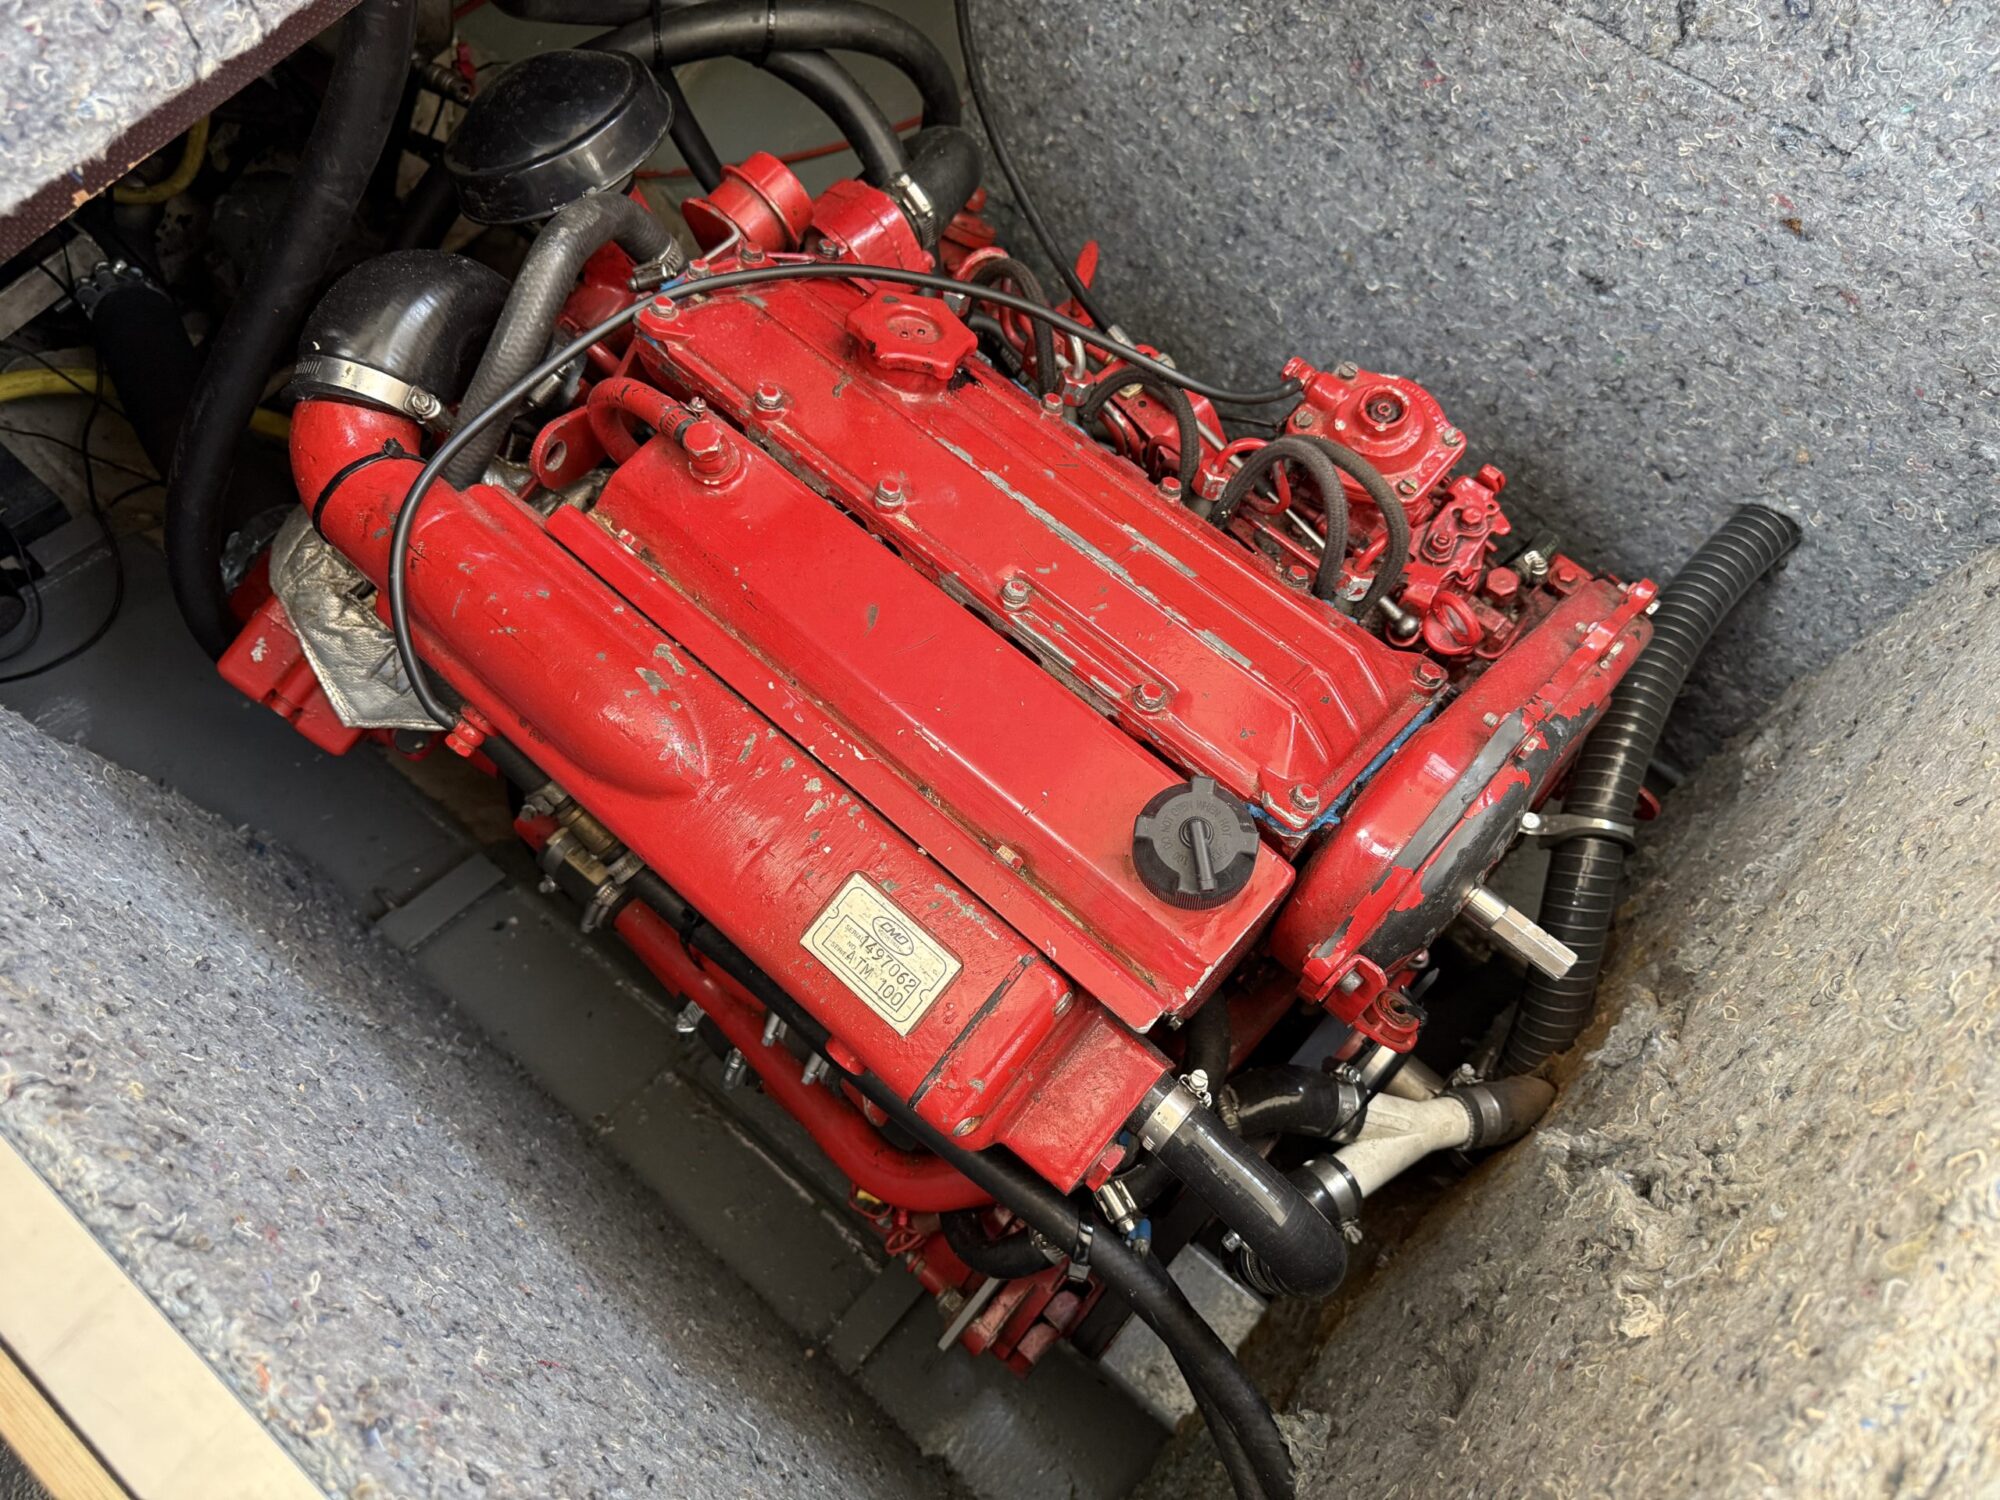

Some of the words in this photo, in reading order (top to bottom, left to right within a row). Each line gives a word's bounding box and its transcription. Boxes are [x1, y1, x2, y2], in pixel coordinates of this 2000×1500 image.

[1162, 816, 1174, 833] NOT
[1195, 800, 1221, 817] WHEN
[1220, 818, 1231, 837] HOT
[845, 924, 864, 944] SERIAL
[859, 934, 918, 994] 1497062
[877, 978, 904, 1006] 100
